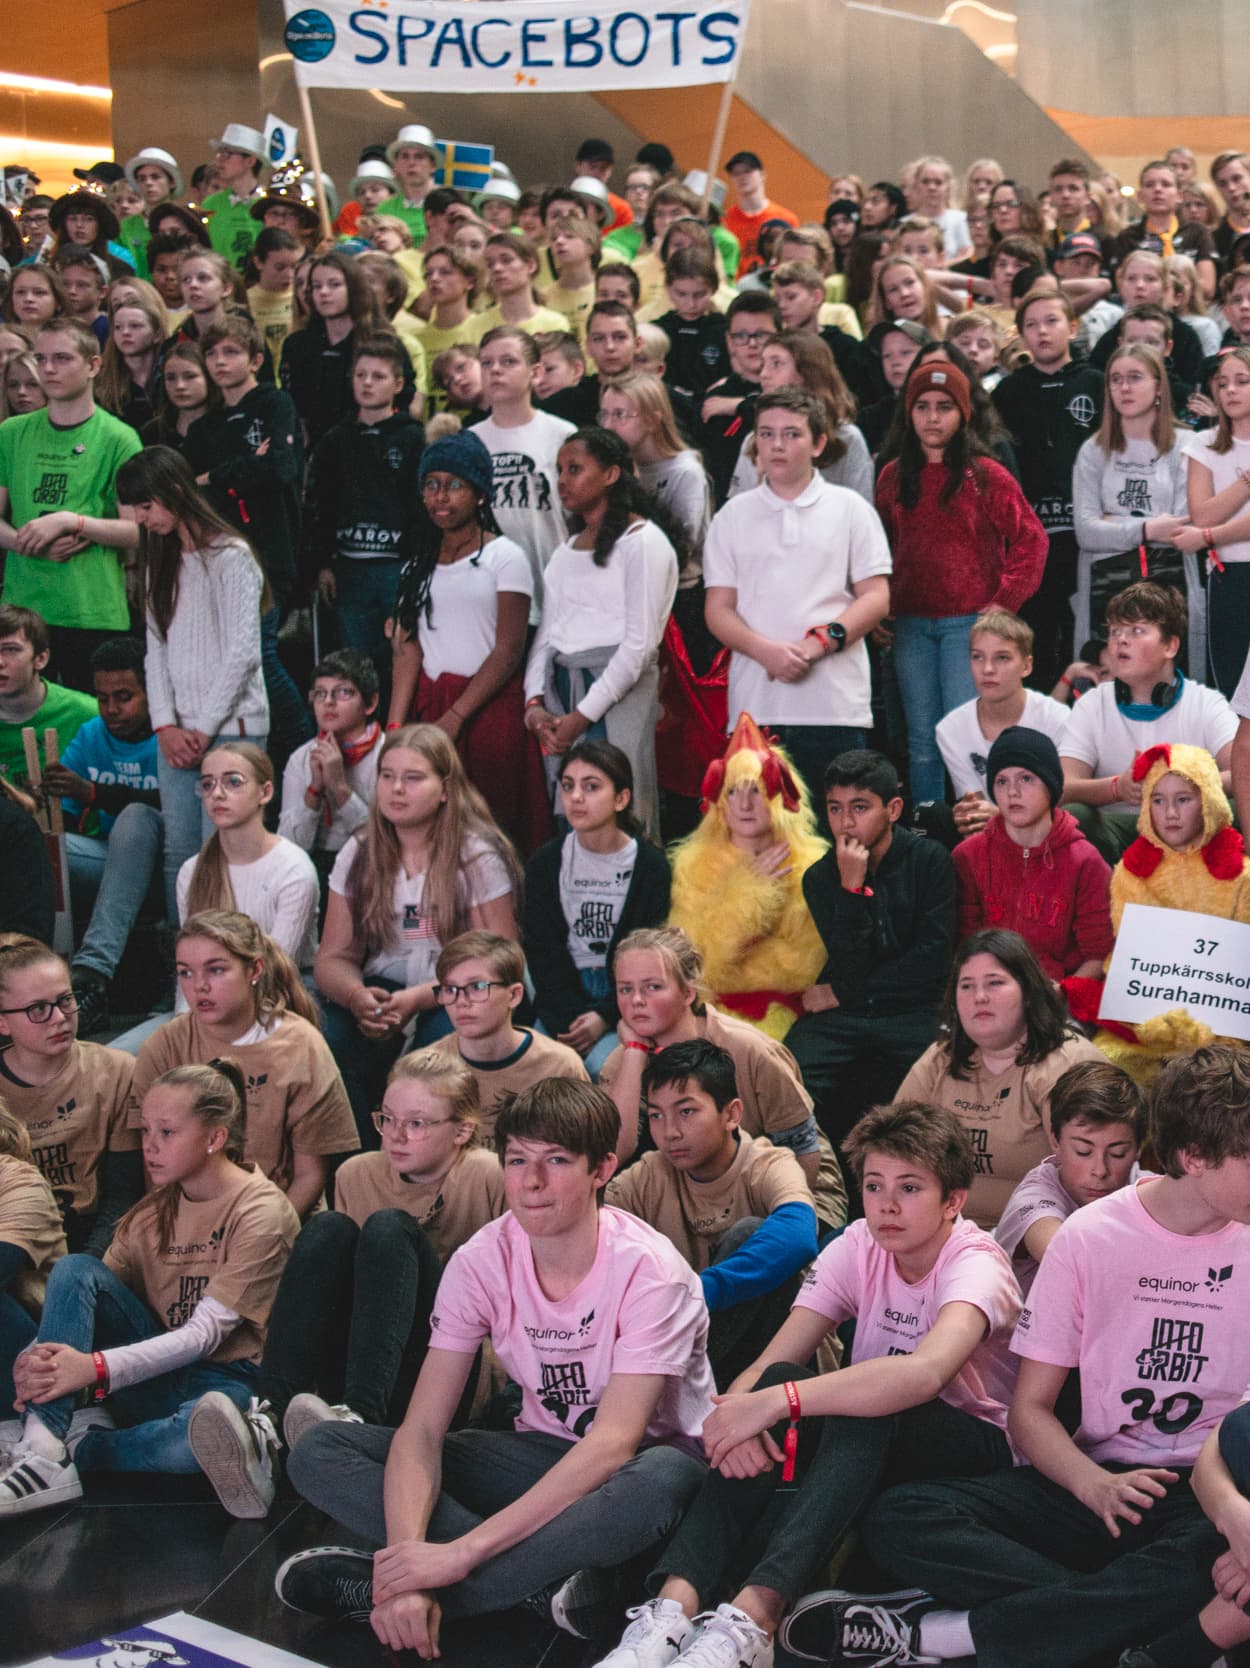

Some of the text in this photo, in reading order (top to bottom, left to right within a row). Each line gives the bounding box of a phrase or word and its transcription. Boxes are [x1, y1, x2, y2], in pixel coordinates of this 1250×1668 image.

[349, 9, 741, 69] SPACEBOTS
[1193, 938, 1220, 956] 37
[1138, 1276, 1200, 1292] equinor
[1151, 1317, 1205, 1354] INTO
